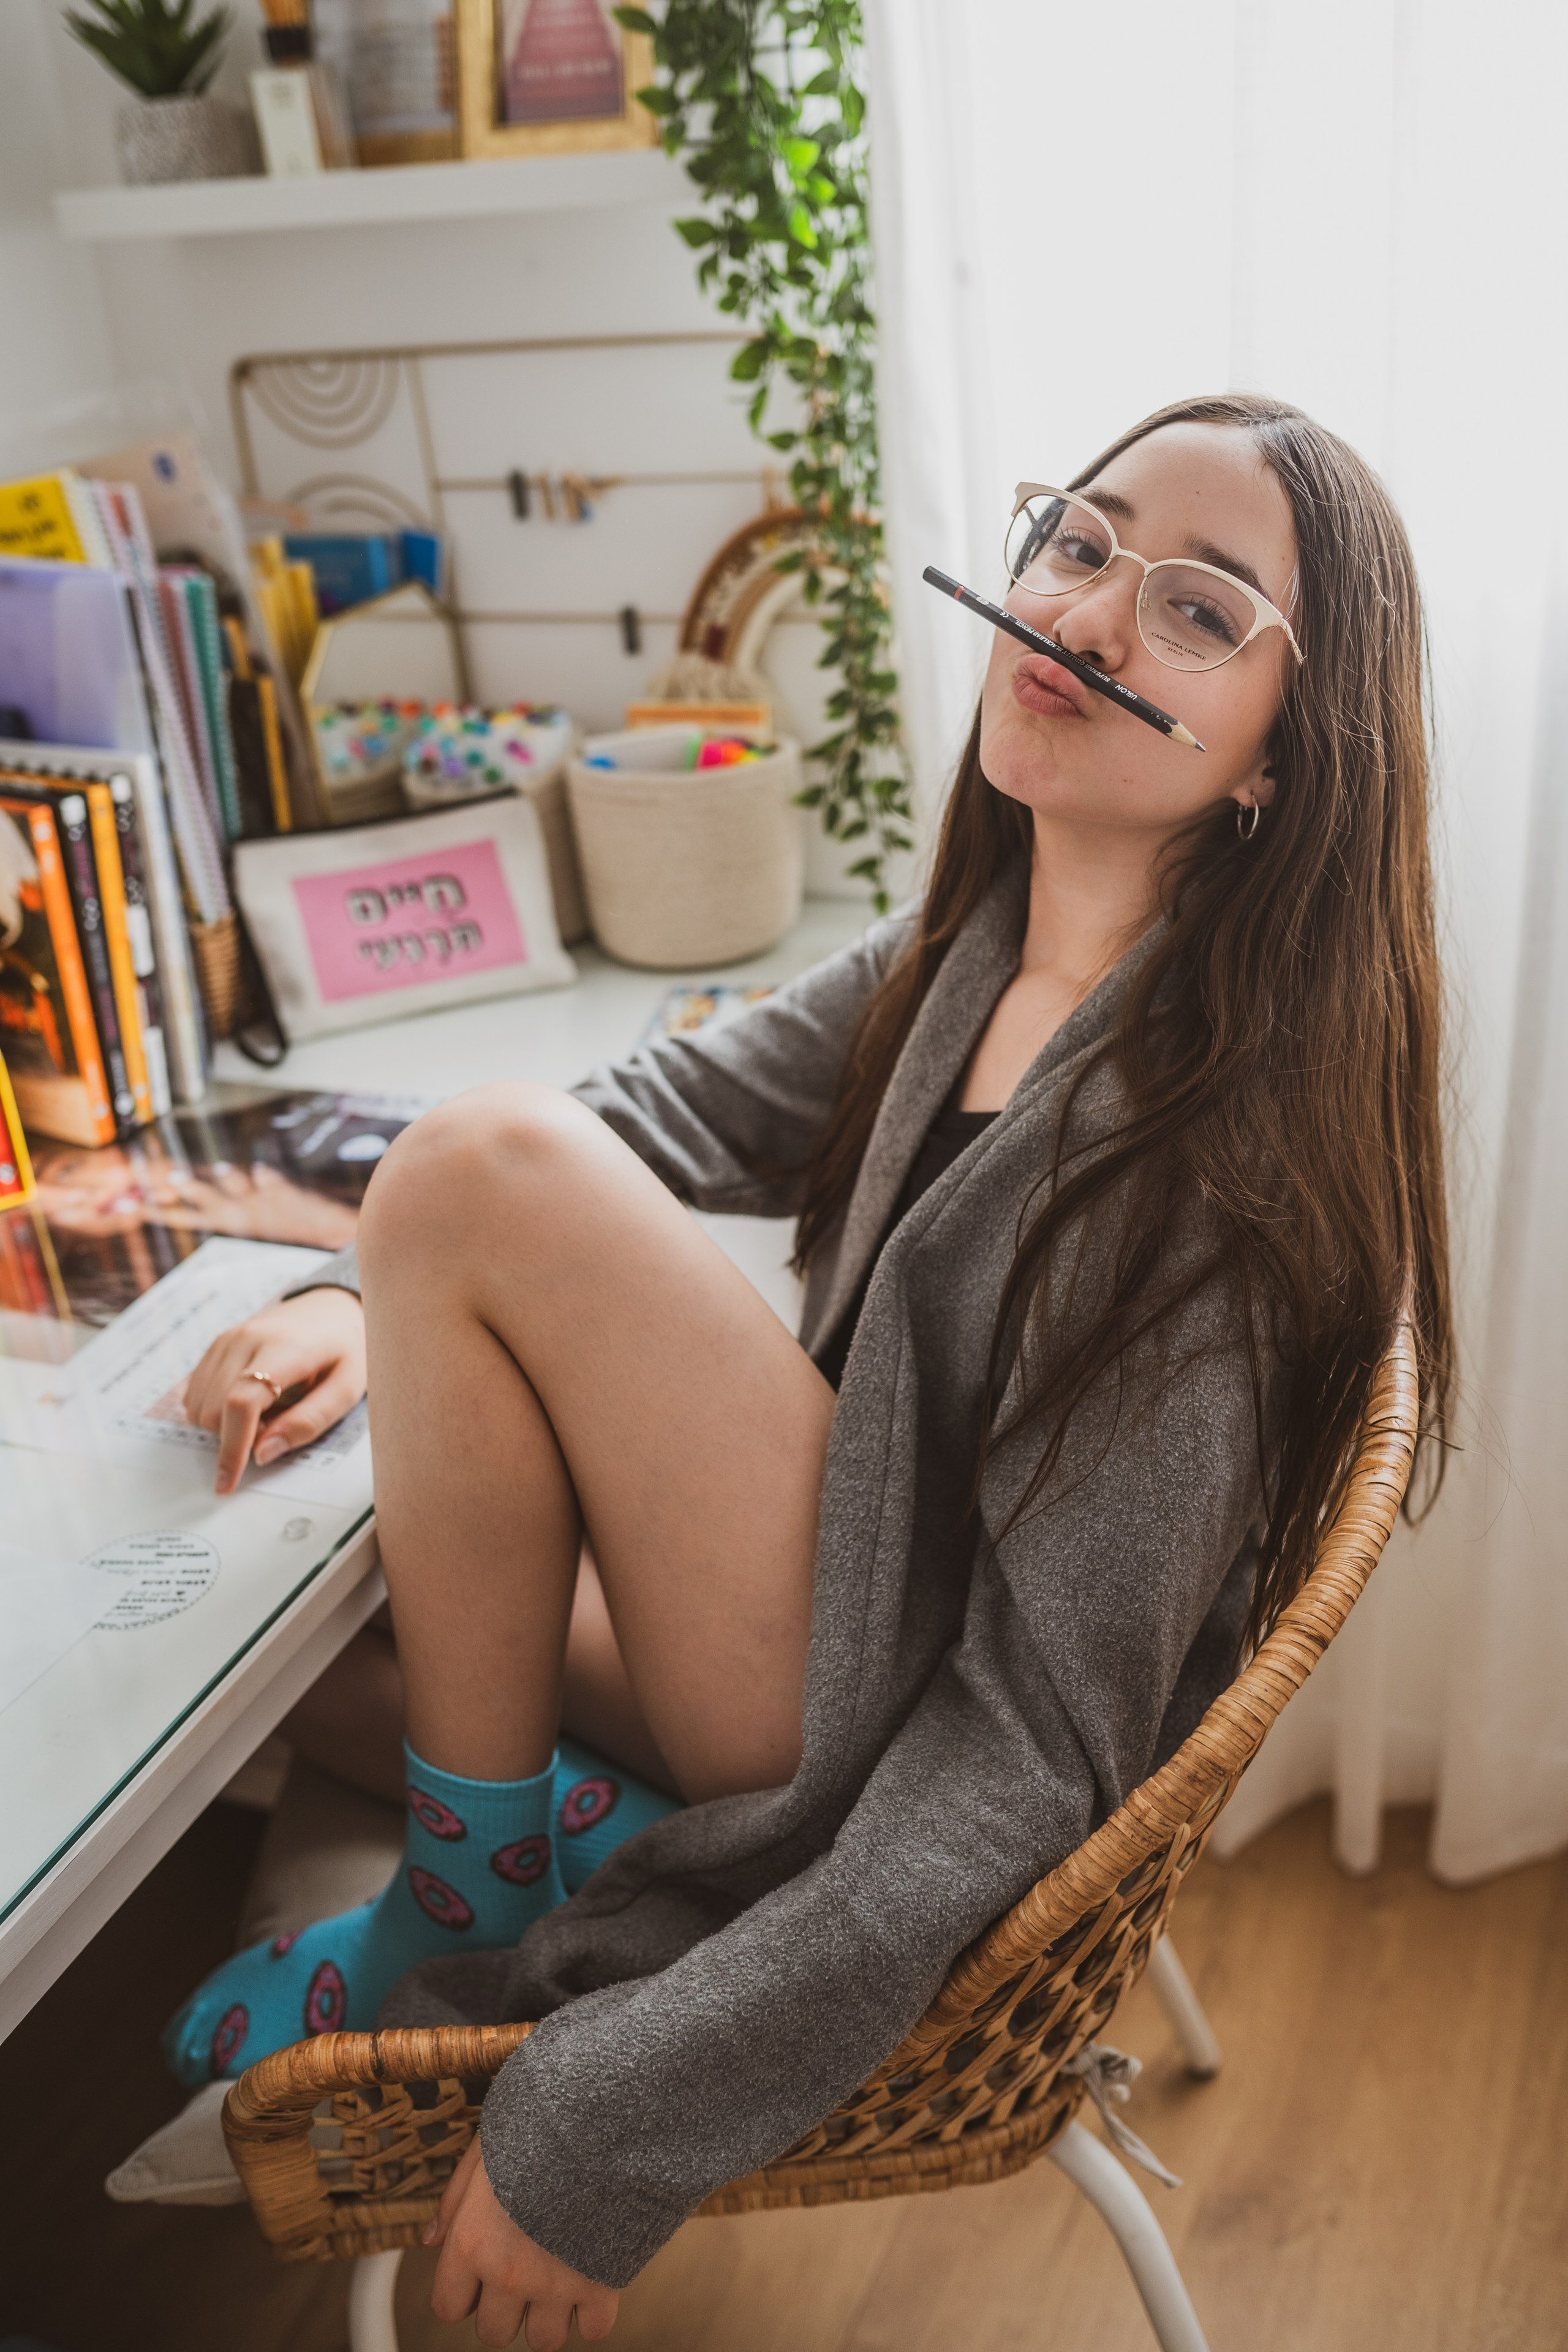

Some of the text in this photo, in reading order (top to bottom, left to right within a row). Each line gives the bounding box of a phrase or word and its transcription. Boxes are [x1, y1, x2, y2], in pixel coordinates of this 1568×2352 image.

[1015, 619, 1033, 635] PENCIL
[1152, 631, 1207, 660] CAROLINA LEMKE
[1167, 647, 1183, 657] BERLIN
[1063, 650, 1085, 665] QUALITY
[1084, 663, 1111, 682] SUPERIOR
[1115, 684, 1137, 700] USLON
[347, 874, 466, 925] חיים
